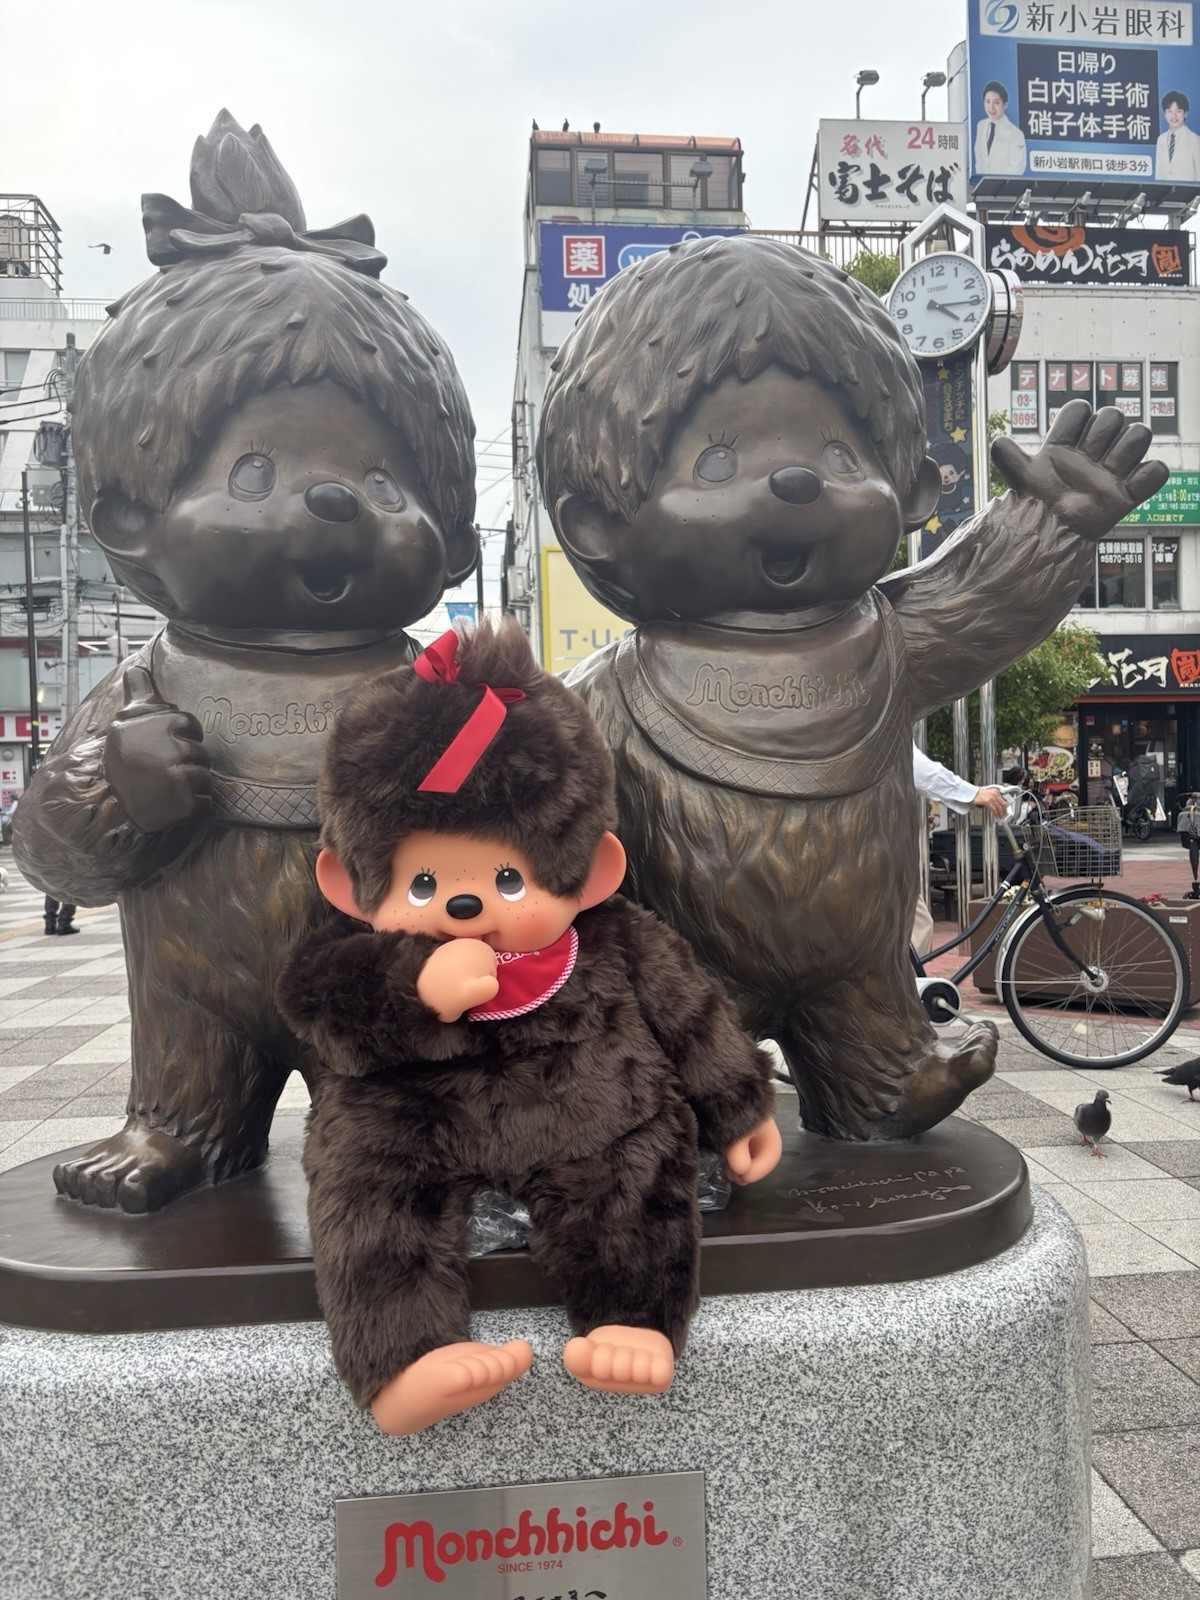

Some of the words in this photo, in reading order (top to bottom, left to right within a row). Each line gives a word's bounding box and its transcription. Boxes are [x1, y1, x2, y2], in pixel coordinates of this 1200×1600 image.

[1026, 2, 1186, 38] 新小岩眼科
[1057, 51, 1117, 75] 日帰り
[1027, 78, 1150, 108] 白内障手術
[1027, 110, 1152, 140] 硝子体手術
[840, 134, 887, 158] 名代
[1033, 156, 1103, 170] 新小岩駅南口
[828, 161, 960, 204] 富士そば
[569, 242, 600, 272] 薬
[930, 265, 945, 277] 12
[953, 266, 959, 277] 1
[912, 275, 925, 287] 11
[964, 278, 976, 290] 2
[926, 284, 949, 294] CITIZEN
[901, 291, 916, 302] 10
[969, 294, 981, 306] 3
[896, 308, 908, 319] 9
[963, 312, 977, 323] 4
[902, 324, 914, 335] 8
[952, 329, 963, 340] 5
[915, 336, 927, 347] 7
[933, 337, 945, 348] 6
[1012, 412, 1037, 426] 3695
[686, 663, 872, 713] Monchhichi
[374, 1501, 669, 1588] Monchhichi
[498, 1563, 533, 1574] SINCE
[538, 1560, 563, 1572] 1974
